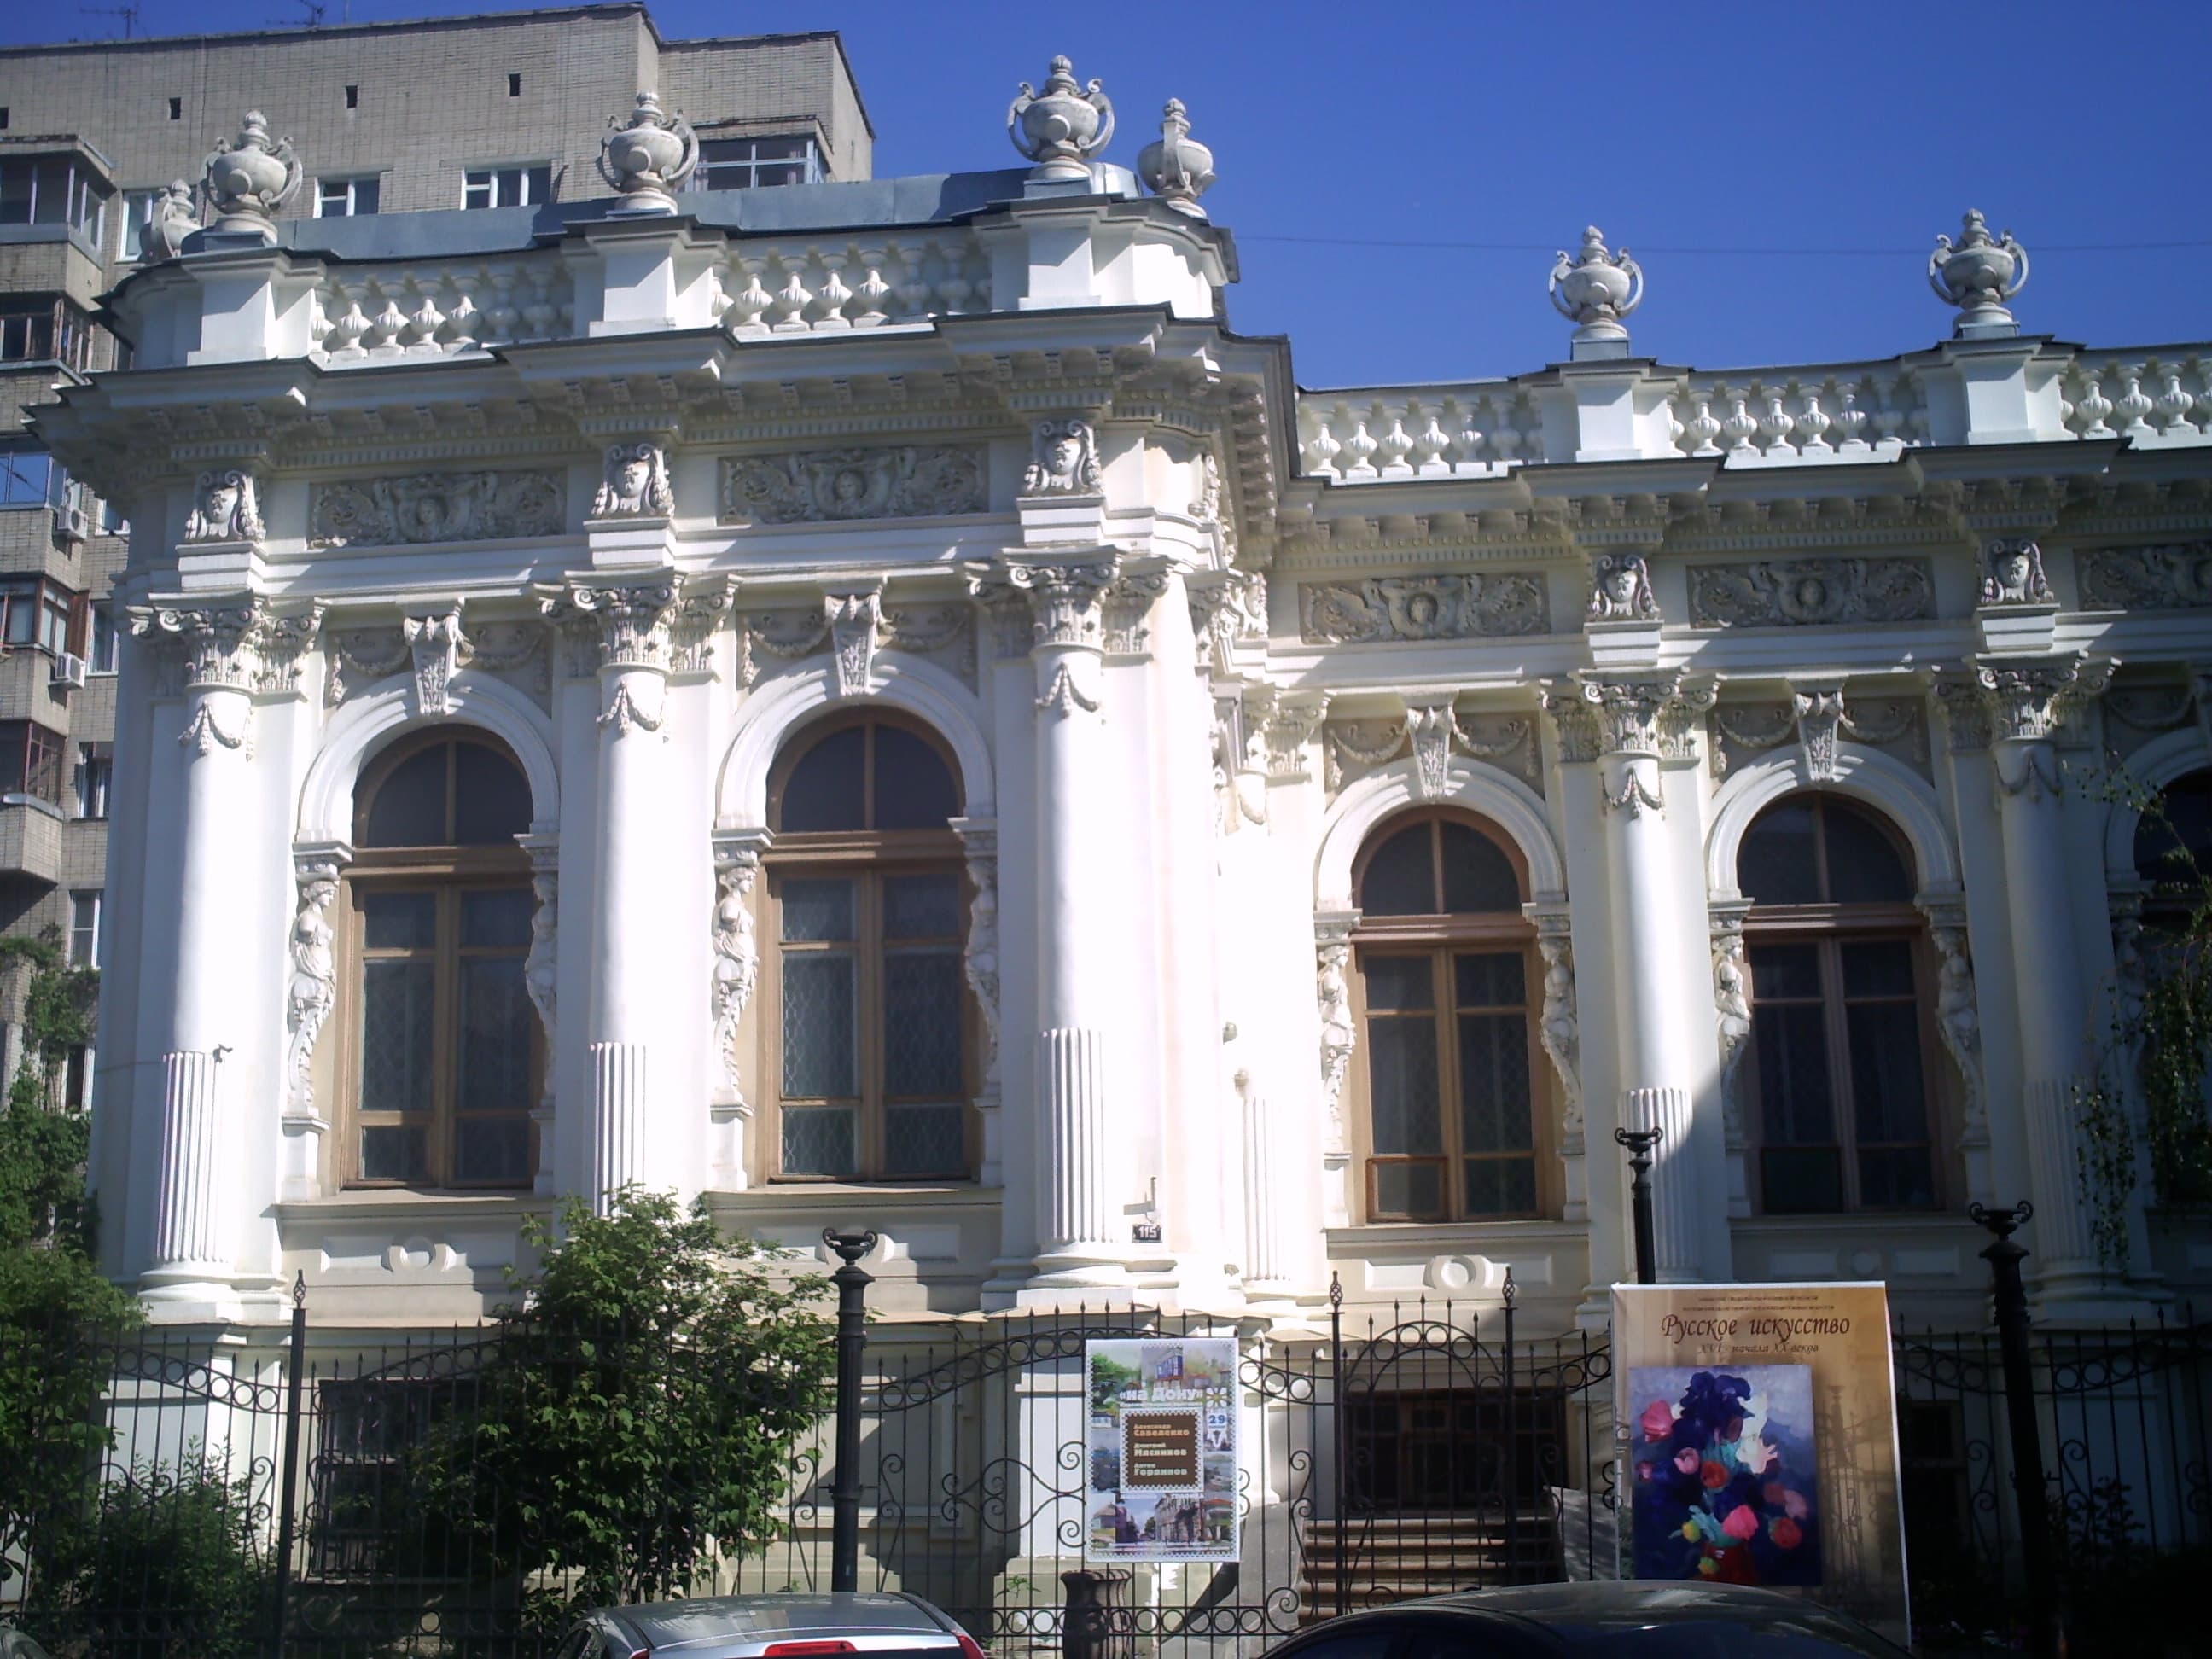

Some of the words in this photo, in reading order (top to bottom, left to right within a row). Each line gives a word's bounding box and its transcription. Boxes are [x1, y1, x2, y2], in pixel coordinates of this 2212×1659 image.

[1138, 1225, 1157, 1238] 115
[1661, 1313, 1738, 1343] Русское
[1749, 1317, 1851, 1343] искусство
[1732, 1344, 1769, 1353] начала
[1790, 1343, 1819, 1354] веков
[1208, 1415, 1225, 1424] 29
[1134, 1448, 1187, 1457] Мясников
